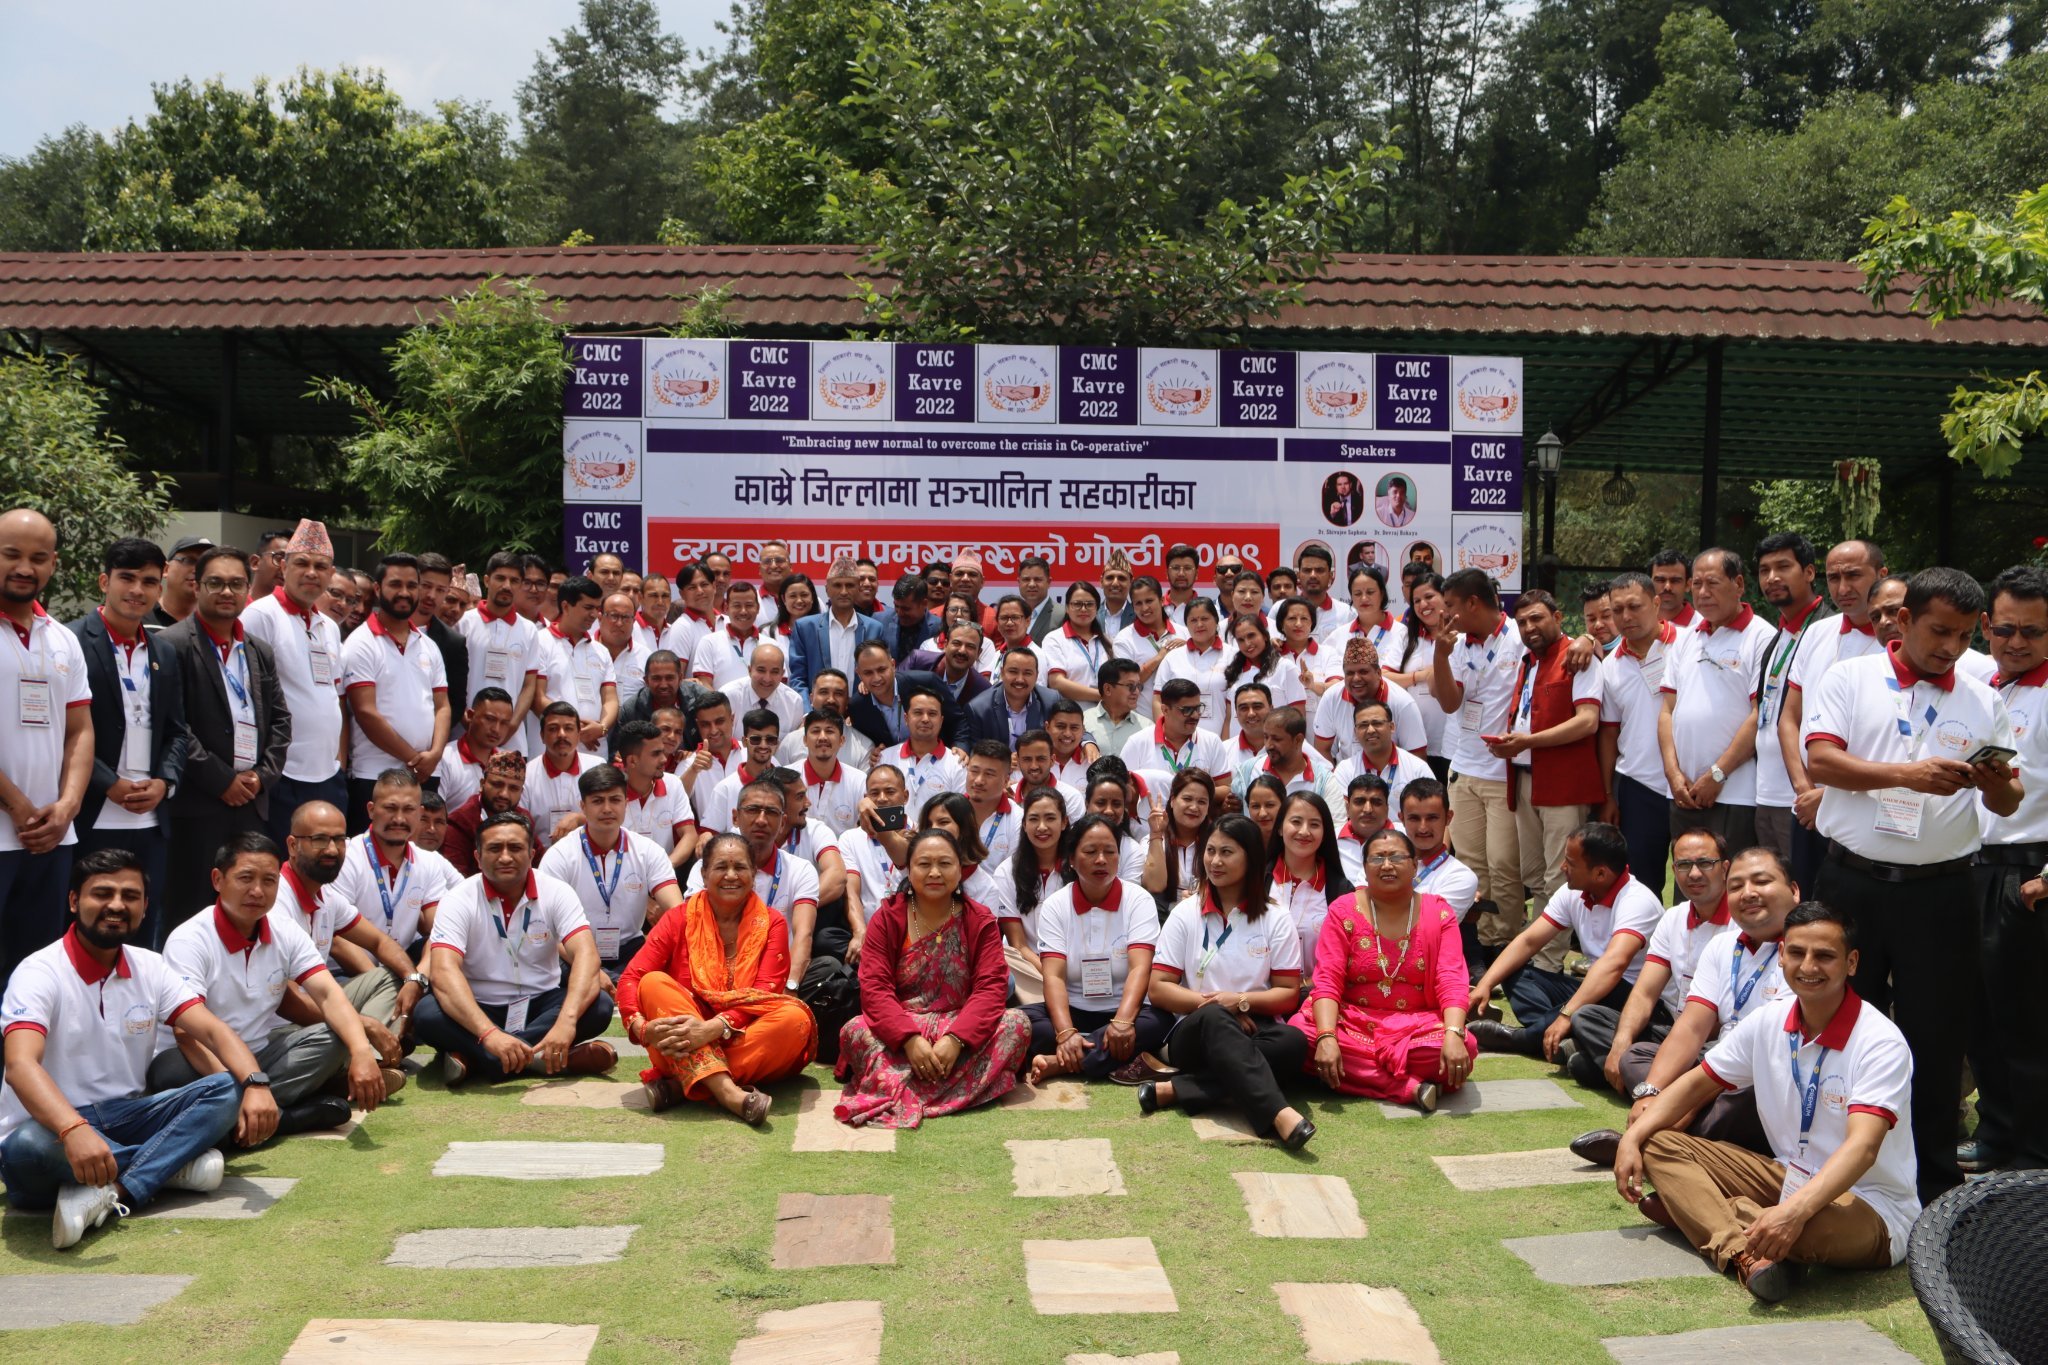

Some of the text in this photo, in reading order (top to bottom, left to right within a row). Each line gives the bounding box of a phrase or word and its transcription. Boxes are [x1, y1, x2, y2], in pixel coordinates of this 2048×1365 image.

[583, 343, 622, 362] CMC
[750, 346, 789, 365] CMC
[916, 349, 955, 367] CMC
[1080, 353, 1117, 371] CMC
[1240, 357, 1277, 374] CMC
[1395, 361, 1431, 378] CMC
[575, 367, 629, 386] Kavre
[741, 370, 796, 389] Kavre
[908, 373, 962, 391] Kavre
[1072, 376, 1125, 394] Kavre
[1232, 380, 1284, 397] Kavre
[1388, 383, 1438, 401] Kavre
[582, 392, 622, 410] 2022
[749, 394, 789, 413] 2022
[915, 397, 955, 415] 2022
[1079, 400, 1118, 418] 2022
[1240, 403, 1277, 420] 2022
[1395, 407, 1431, 424] 2022
[782, 435, 852, 450] "Embracing
[854, 439, 879, 449] new
[882, 438, 924, 449] normal
[926, 439, 938, 449] to
[941, 440, 996, 450] overcome
[999, 439, 1019, 450] the
[1021, 439, 1053, 451] crisis
[1055, 439, 1068, 451] in
[1340, 444, 1396, 458] Speakers
[1471, 442, 1506, 459] CMC
[1463, 465, 1513, 482] Kavre
[735, 468, 1197, 510] काभ्रे जिल्लामा सञ्चालित सहकारीका
[1470, 488, 1506, 505] 2022
[582, 511, 621, 529] CMC
[575, 535, 629, 553] Kavre
[1171, 542, 1262, 570] ०७९
[1738, 981, 1755, 1004] PREMIUM
[1805, 1089, 1815, 1117] PREMIUM
